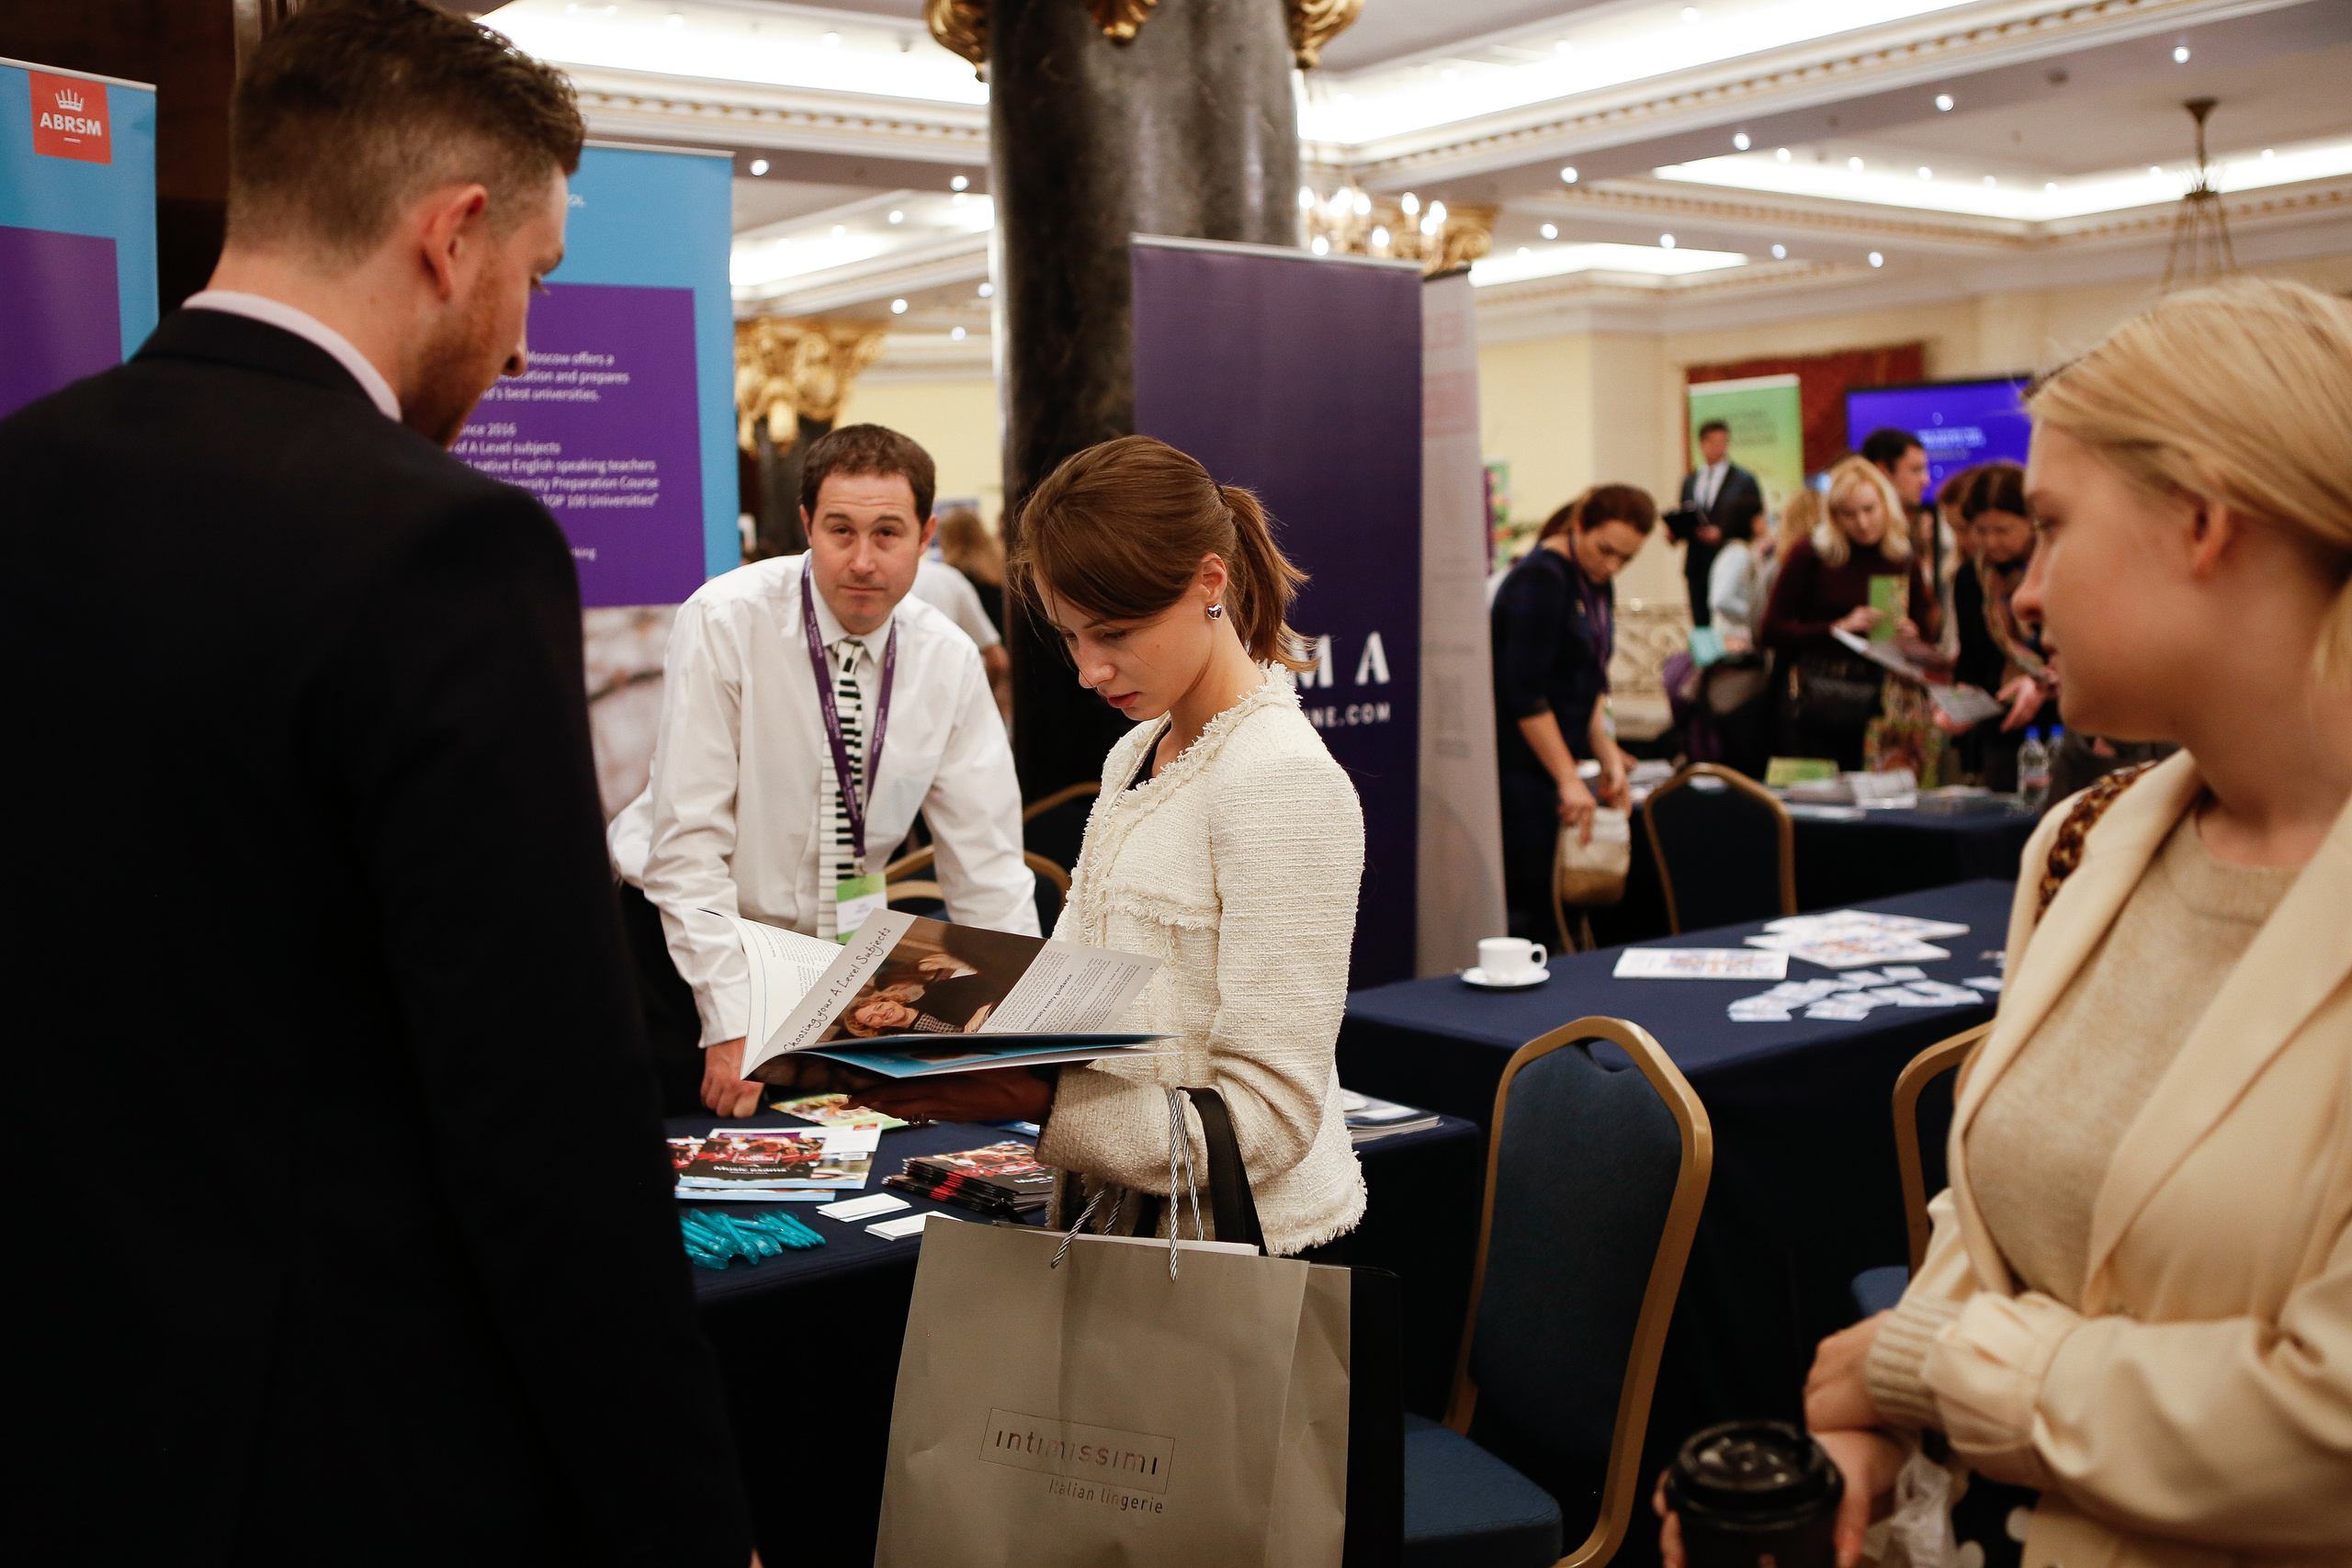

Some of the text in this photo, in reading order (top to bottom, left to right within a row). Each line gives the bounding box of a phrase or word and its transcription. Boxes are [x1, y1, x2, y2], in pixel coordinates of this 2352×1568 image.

[40, 112, 102, 137] ABRSM
[526, 351, 570, 366] Moscow
[571, 351, 605, 367] offers
[555, 369, 578, 384] and
[579, 371, 630, 386] prepares
[504, 386, 531, 401] best
[487, 422, 517, 438] 2016
[454, 440, 562, 457] of A Level subjects
[472, 459, 511, 473] native
[512, 458, 555, 476] English
[556, 458, 606, 476] speaking
[607, 458, 657, 474] teachers
[551, 476, 618, 492] Preparation
[619, 475, 661, 491] Course
[783, 1017, 822, 1051] Choosing
[817, 998, 833, 1022] your
[830, 987, 842, 998] A
[836, 964, 862, 989] Level
[855, 927, 891, 965] Subjects
[995, 1430, 1158, 1475] intimissimi
[1100, 1487, 1163, 1514] lingerie
